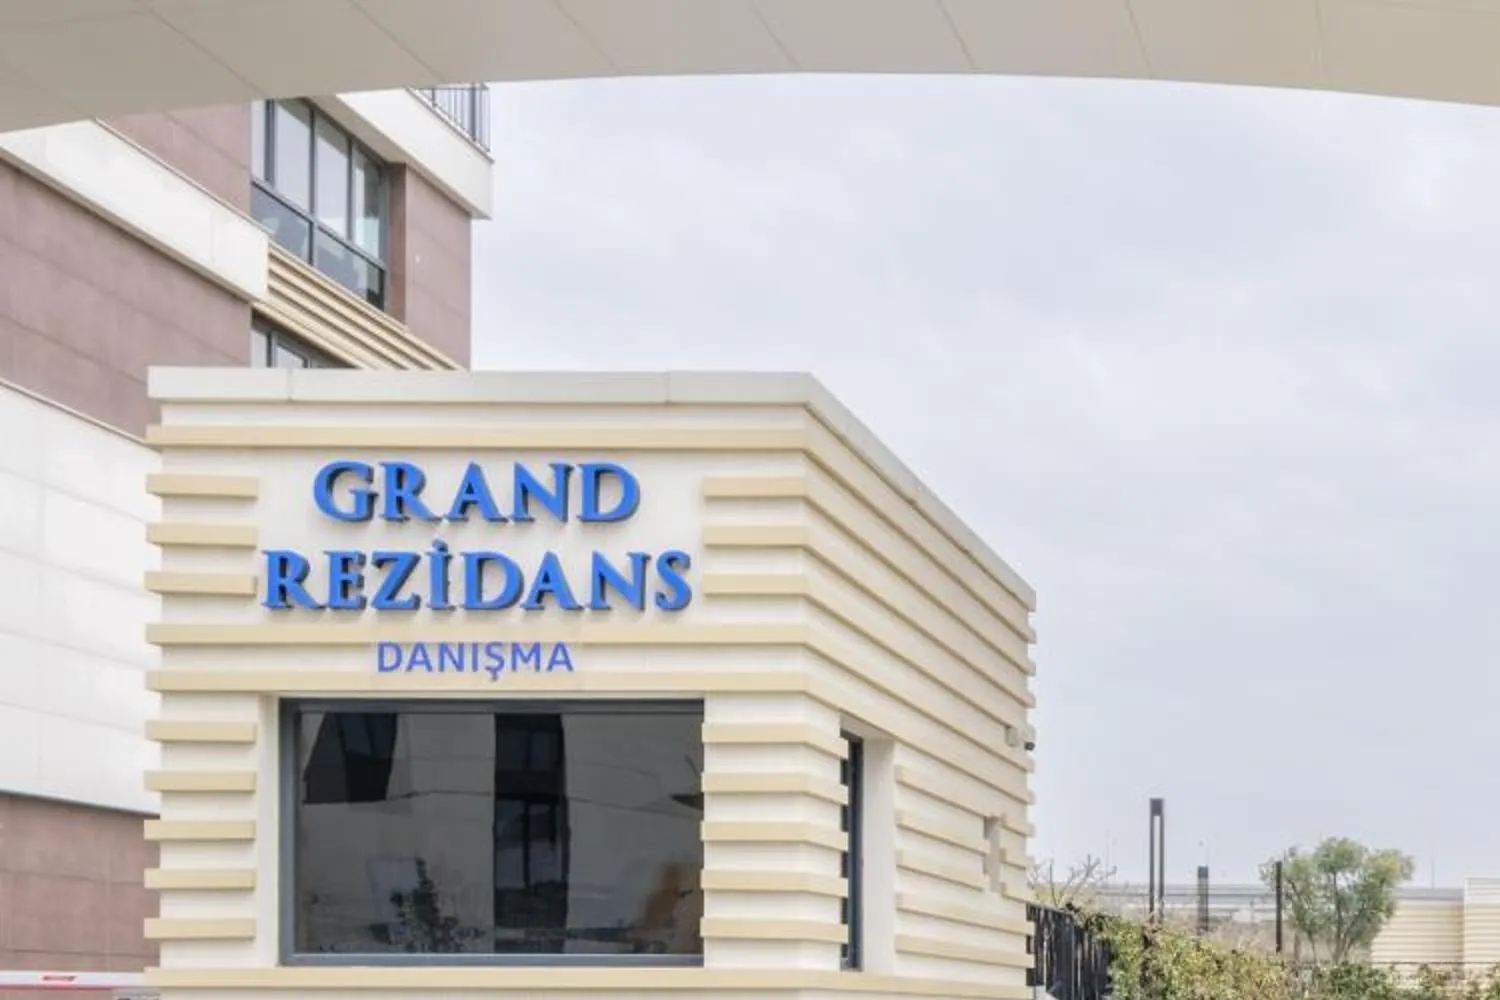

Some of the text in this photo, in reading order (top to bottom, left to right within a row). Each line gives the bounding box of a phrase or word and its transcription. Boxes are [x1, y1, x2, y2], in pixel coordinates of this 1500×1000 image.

[313, 460, 640, 524] GRAND
[260, 537, 693, 613] REZİDANS
[377, 641, 575, 681] DANIŞMA
